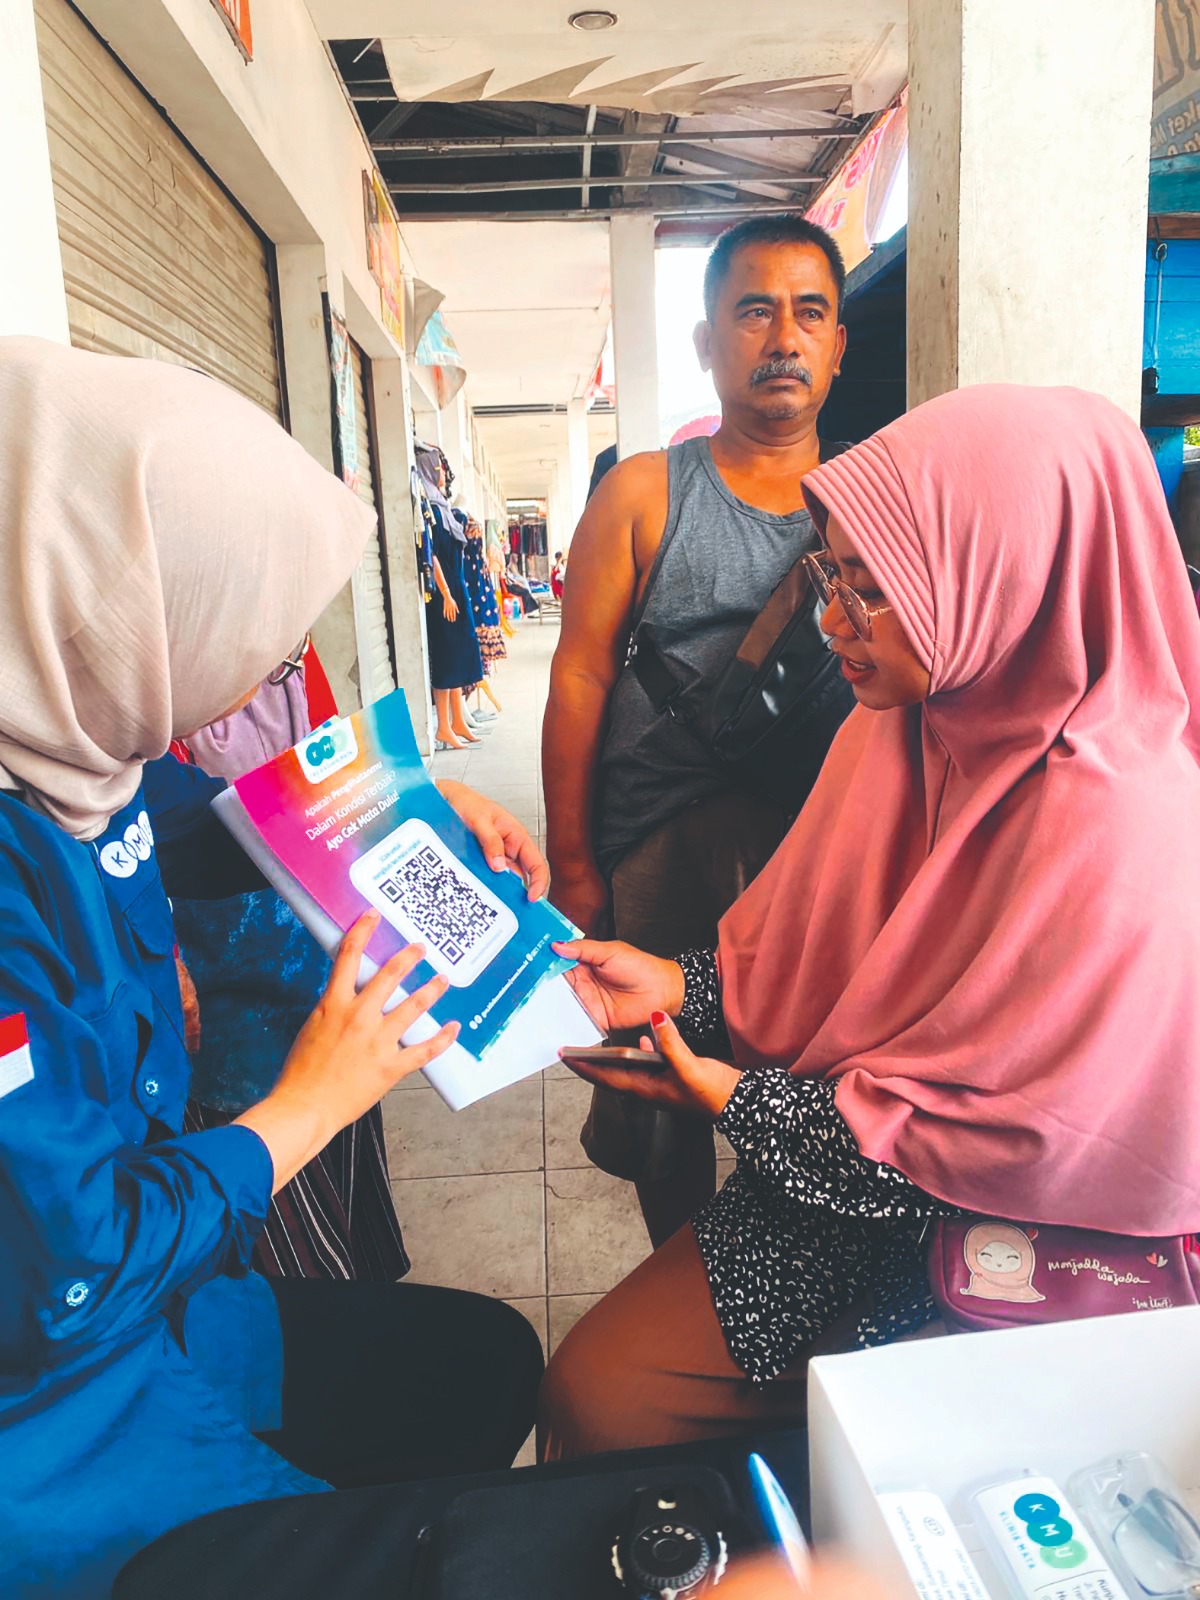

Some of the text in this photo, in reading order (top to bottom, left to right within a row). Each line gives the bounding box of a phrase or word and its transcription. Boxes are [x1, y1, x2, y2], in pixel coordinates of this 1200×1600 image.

[304, 794, 332, 816] Apakah
[331, 762, 383, 798] Penglihatanmu
[305, 769, 396, 840] Dalam Kondisi Terbaik?
[326, 789, 400, 850] Ayo Cek Mata Dulu!
[999, 1511, 1036, 1569] KLINIK MATA
